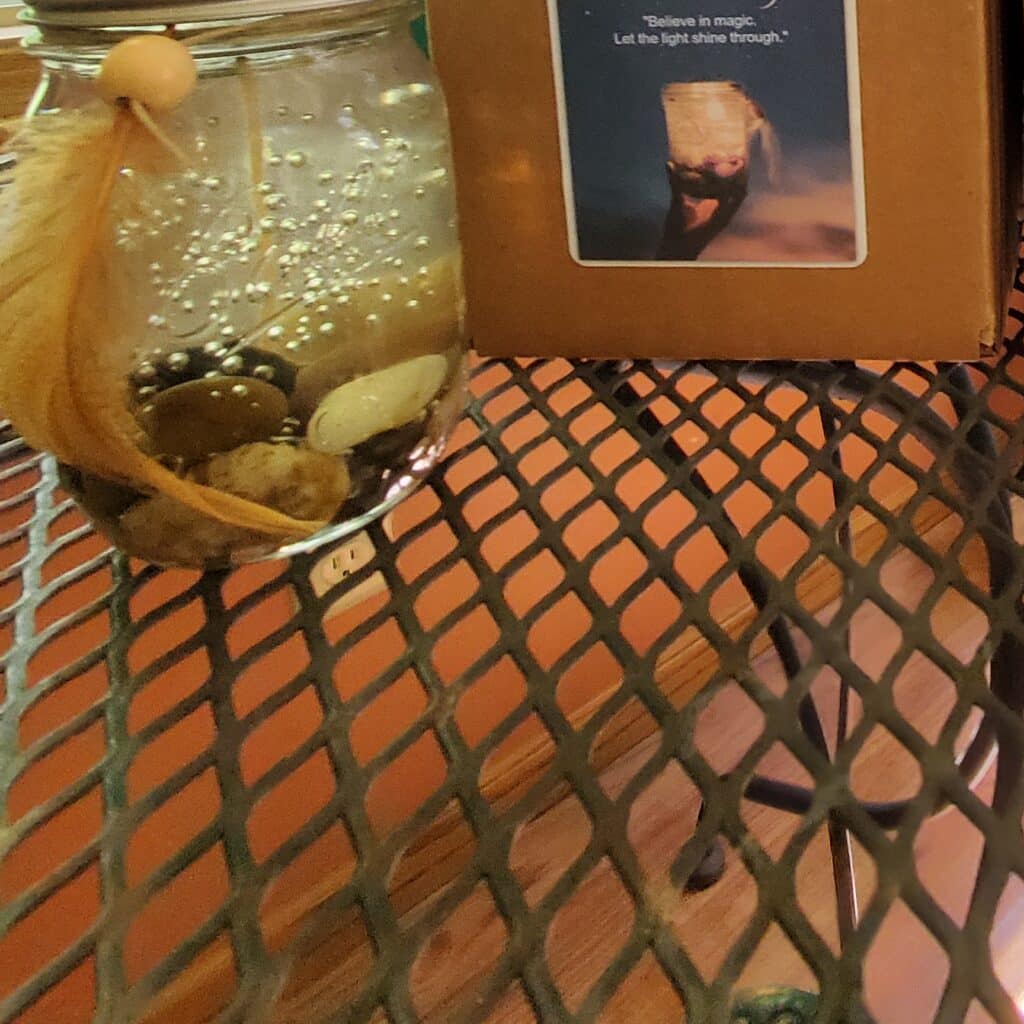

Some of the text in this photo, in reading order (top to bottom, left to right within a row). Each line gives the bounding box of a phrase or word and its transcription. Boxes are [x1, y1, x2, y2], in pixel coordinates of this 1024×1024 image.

[698, 14, 711, 27] in
[614, 32, 636, 45] Let
[637, 32, 660, 44] the
[660, 32, 690, 47] light
[691, 31, 728, 44] shine
